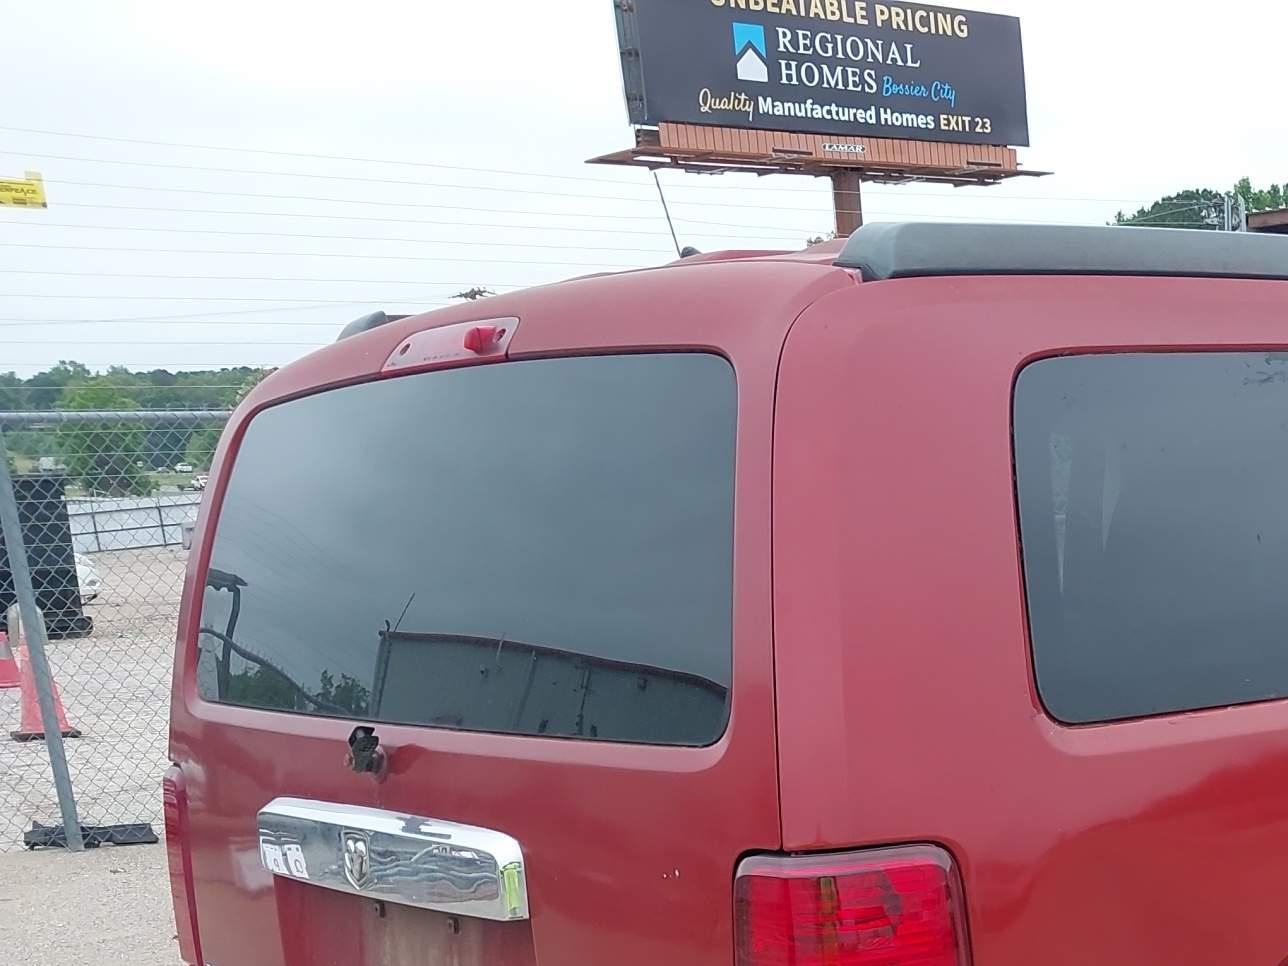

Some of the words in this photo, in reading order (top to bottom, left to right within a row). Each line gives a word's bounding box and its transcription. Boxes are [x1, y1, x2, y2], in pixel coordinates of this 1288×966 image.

[711, 0, 869, 25] EATABLE
[875, 4, 969, 38] PRICING
[776, 27, 921, 68] REGIONAL
[778, 59, 878, 94] HOMES
[882, 75, 929, 97] Bossier
[931, 80, 956, 108] City
[699, 88, 754, 122] Quality
[757, 95, 876, 124] Manufactured
[879, 107, 935, 129] Homes
[939, 113, 971, 132] EXIT
[974, 117, 992, 133] 23
[824, 143, 865, 154] LAMAR
